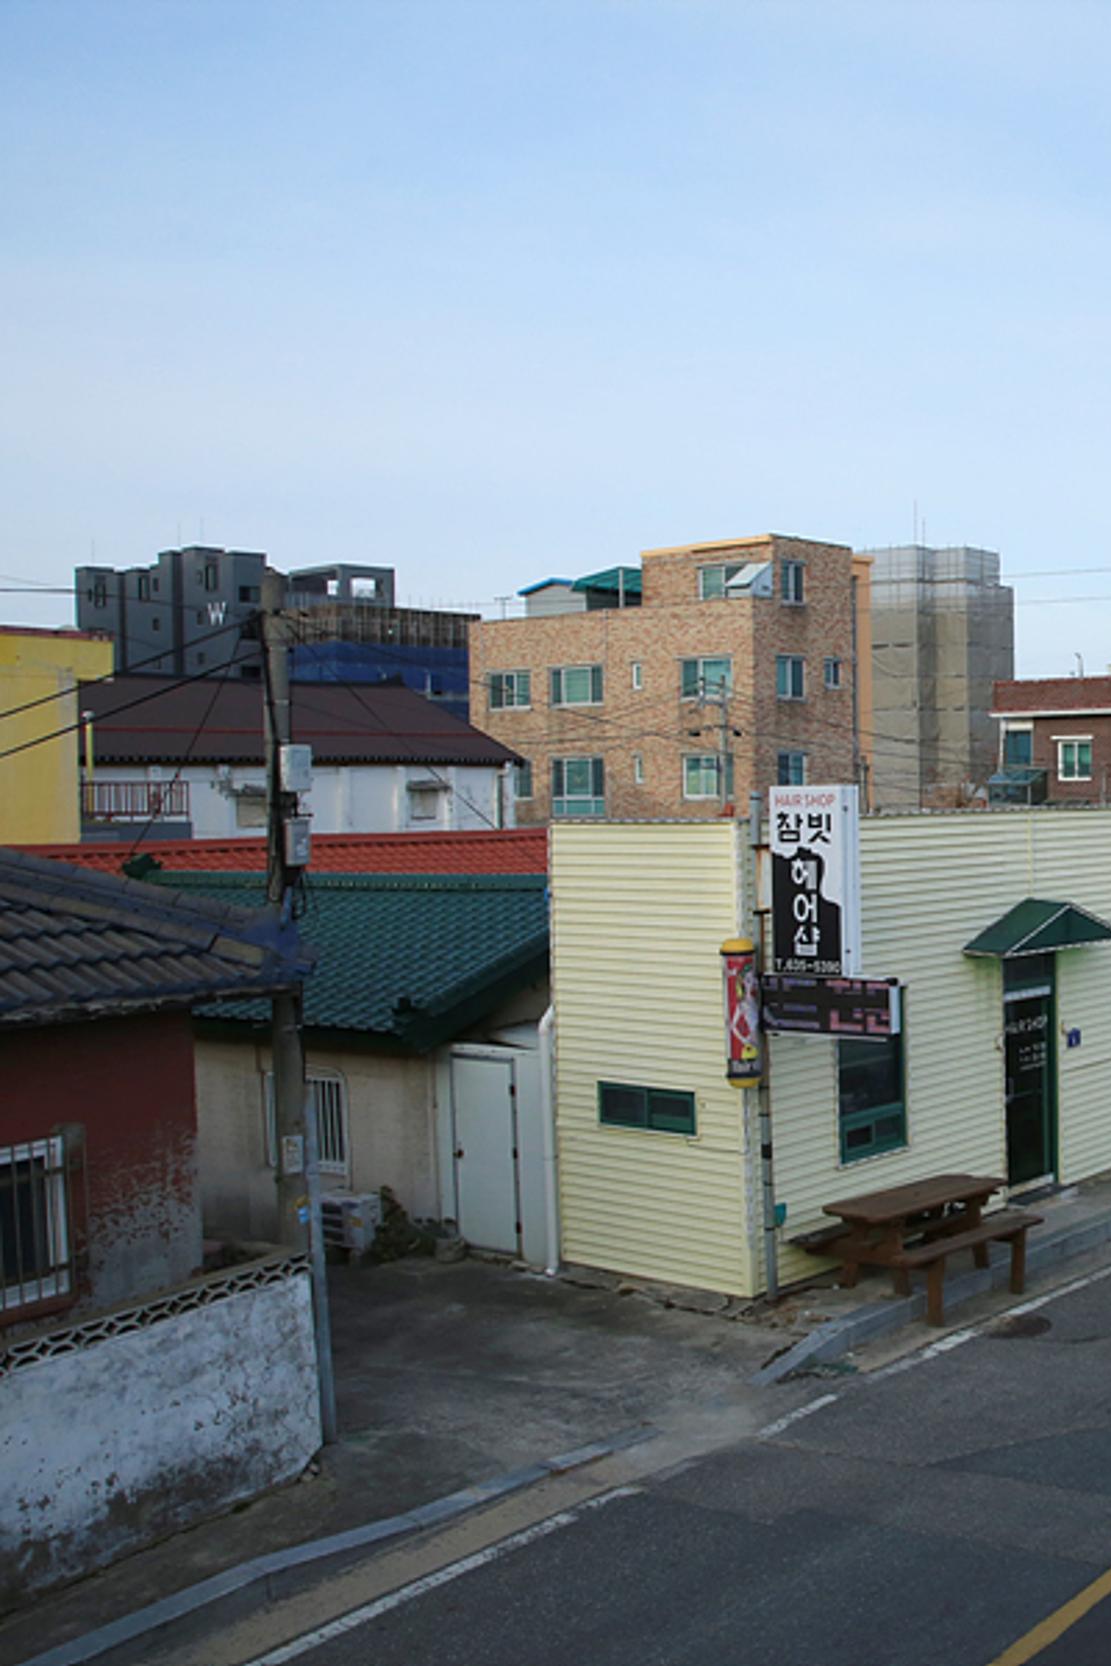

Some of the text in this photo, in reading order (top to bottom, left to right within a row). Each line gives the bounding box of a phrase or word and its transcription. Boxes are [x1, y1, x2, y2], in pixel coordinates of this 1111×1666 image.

[775, 792, 836, 808] HAIR SHOP
[776, 811, 832, 844] 참빗
[791, 859, 821, 956] 헤어샵
